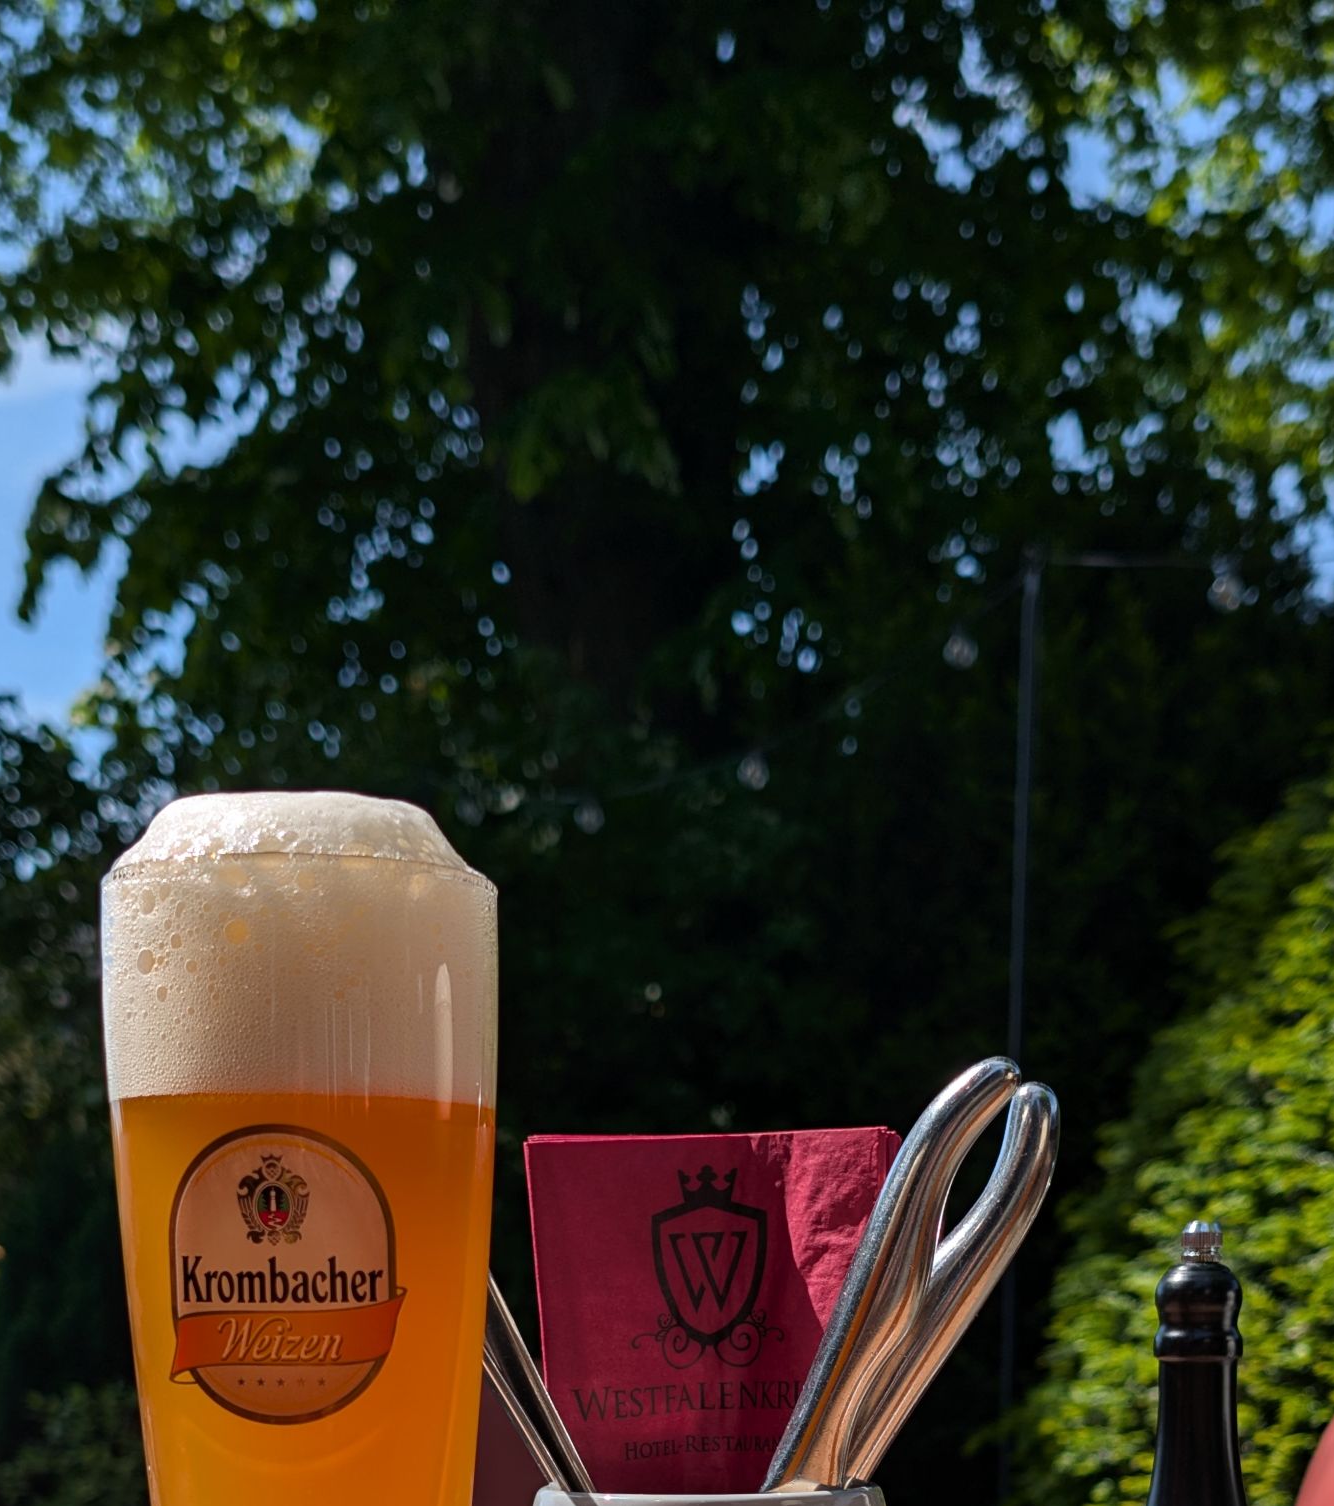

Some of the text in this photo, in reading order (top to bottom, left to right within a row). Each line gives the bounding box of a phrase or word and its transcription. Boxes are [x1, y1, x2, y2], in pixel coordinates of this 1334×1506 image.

[181, 1255, 384, 1303] Krombacher
[218, 1316, 345, 1362] Weizen
[624, 1434, 781, 1461] HOTEL-RESTAURAN
